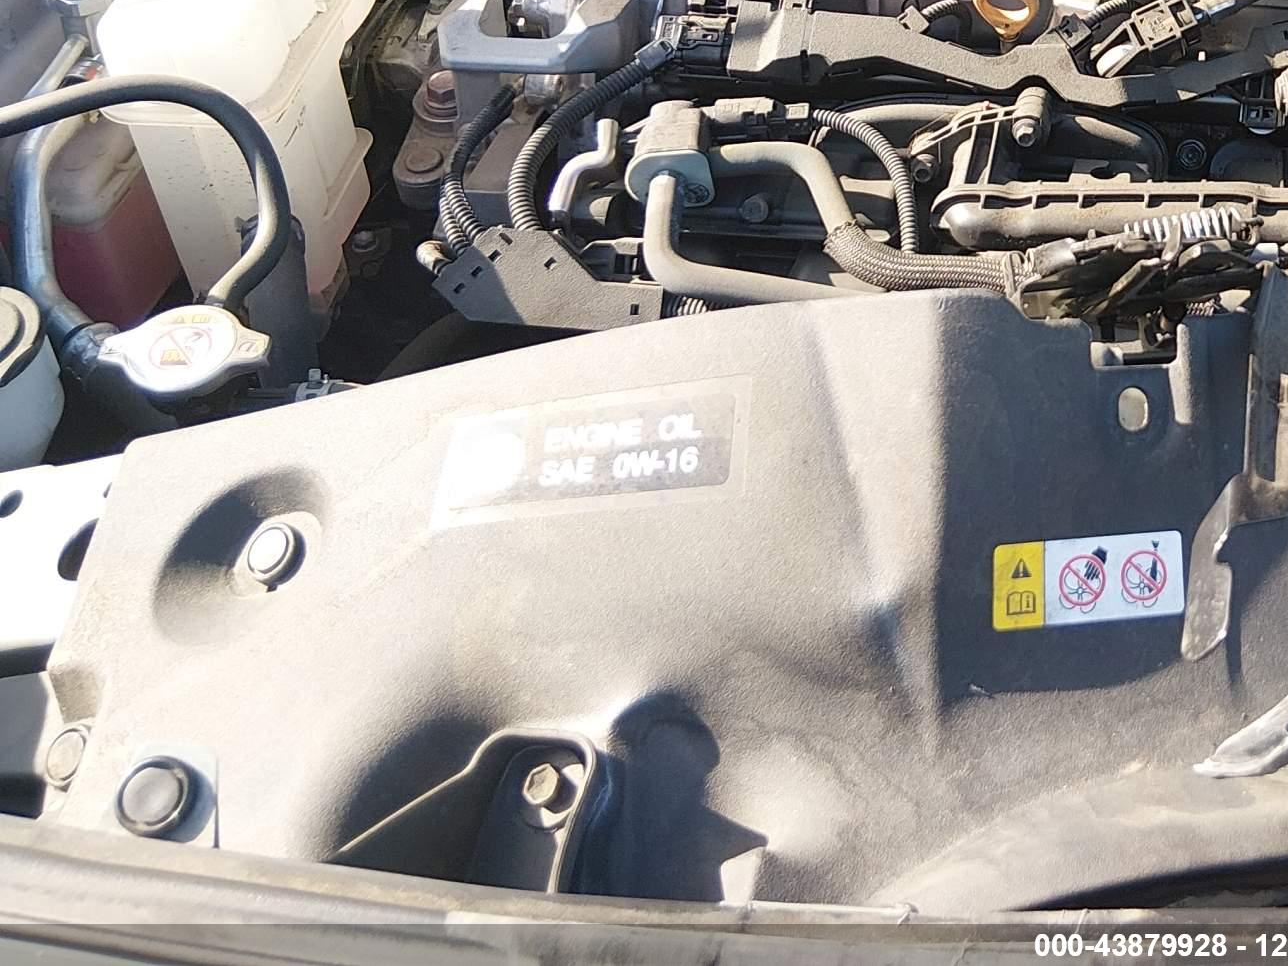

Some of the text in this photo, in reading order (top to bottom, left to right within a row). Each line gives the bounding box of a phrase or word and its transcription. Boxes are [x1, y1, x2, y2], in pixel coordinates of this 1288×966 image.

[544, 413, 702, 450] ENGINE OIL
[540, 445, 700, 484] SAE 0W-16
